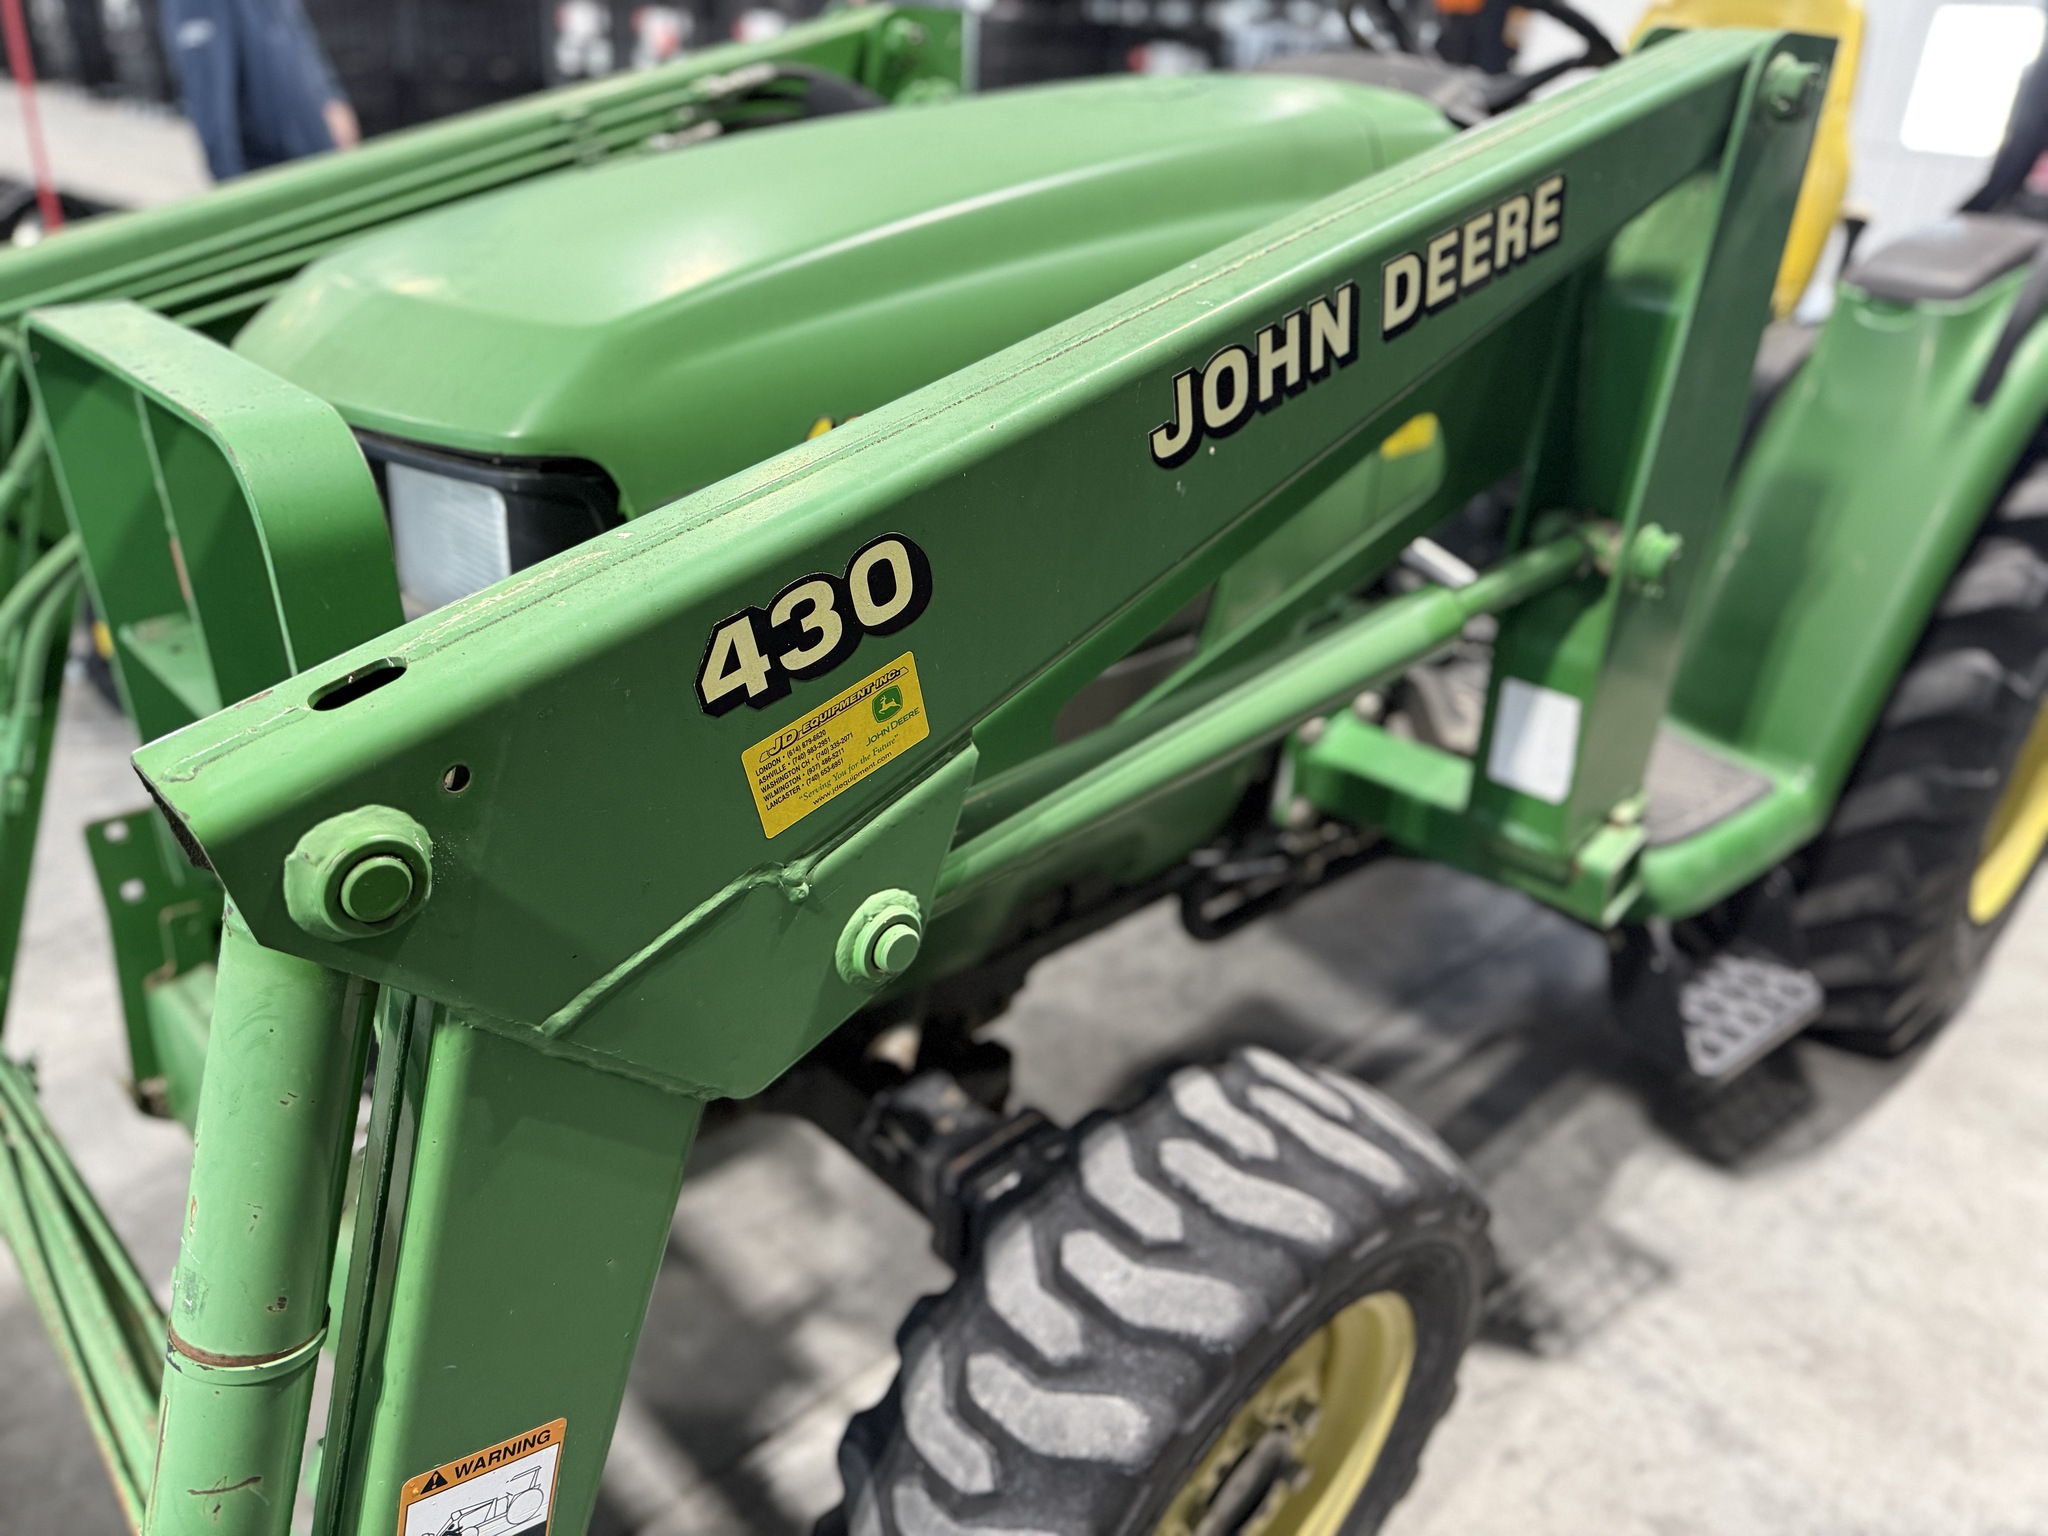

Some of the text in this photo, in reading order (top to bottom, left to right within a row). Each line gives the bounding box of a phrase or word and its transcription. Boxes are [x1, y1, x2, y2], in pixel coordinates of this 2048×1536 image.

[1150, 173, 1565, 465] JOHN DEERE
[697, 535, 926, 712] 430
[767, 668, 901, 757] JD EQUIPMENT INC.
[866, 707, 920, 746] JOHN DEERE
[755, 757, 781, 776] LONDON
[786, 744, 801, 759] (614)
[758, 736, 831, 785] ASHVILLE (740) 983-2951
[760, 732, 854, 793] WASHINGTON CH (740) 335-2071
[763, 747, 845, 802] WILMINGTON (937) 486-5211
[765, 758, 844, 811] LANCASTER (740) 653-6951
[812, 752, 892, 805] www.jdequipment.com
[832, 769, 847, 782] You
[848, 763, 859, 774] for
[860, 755, 871, 765] the
[454, 1429, 551, 1479] WARNING
